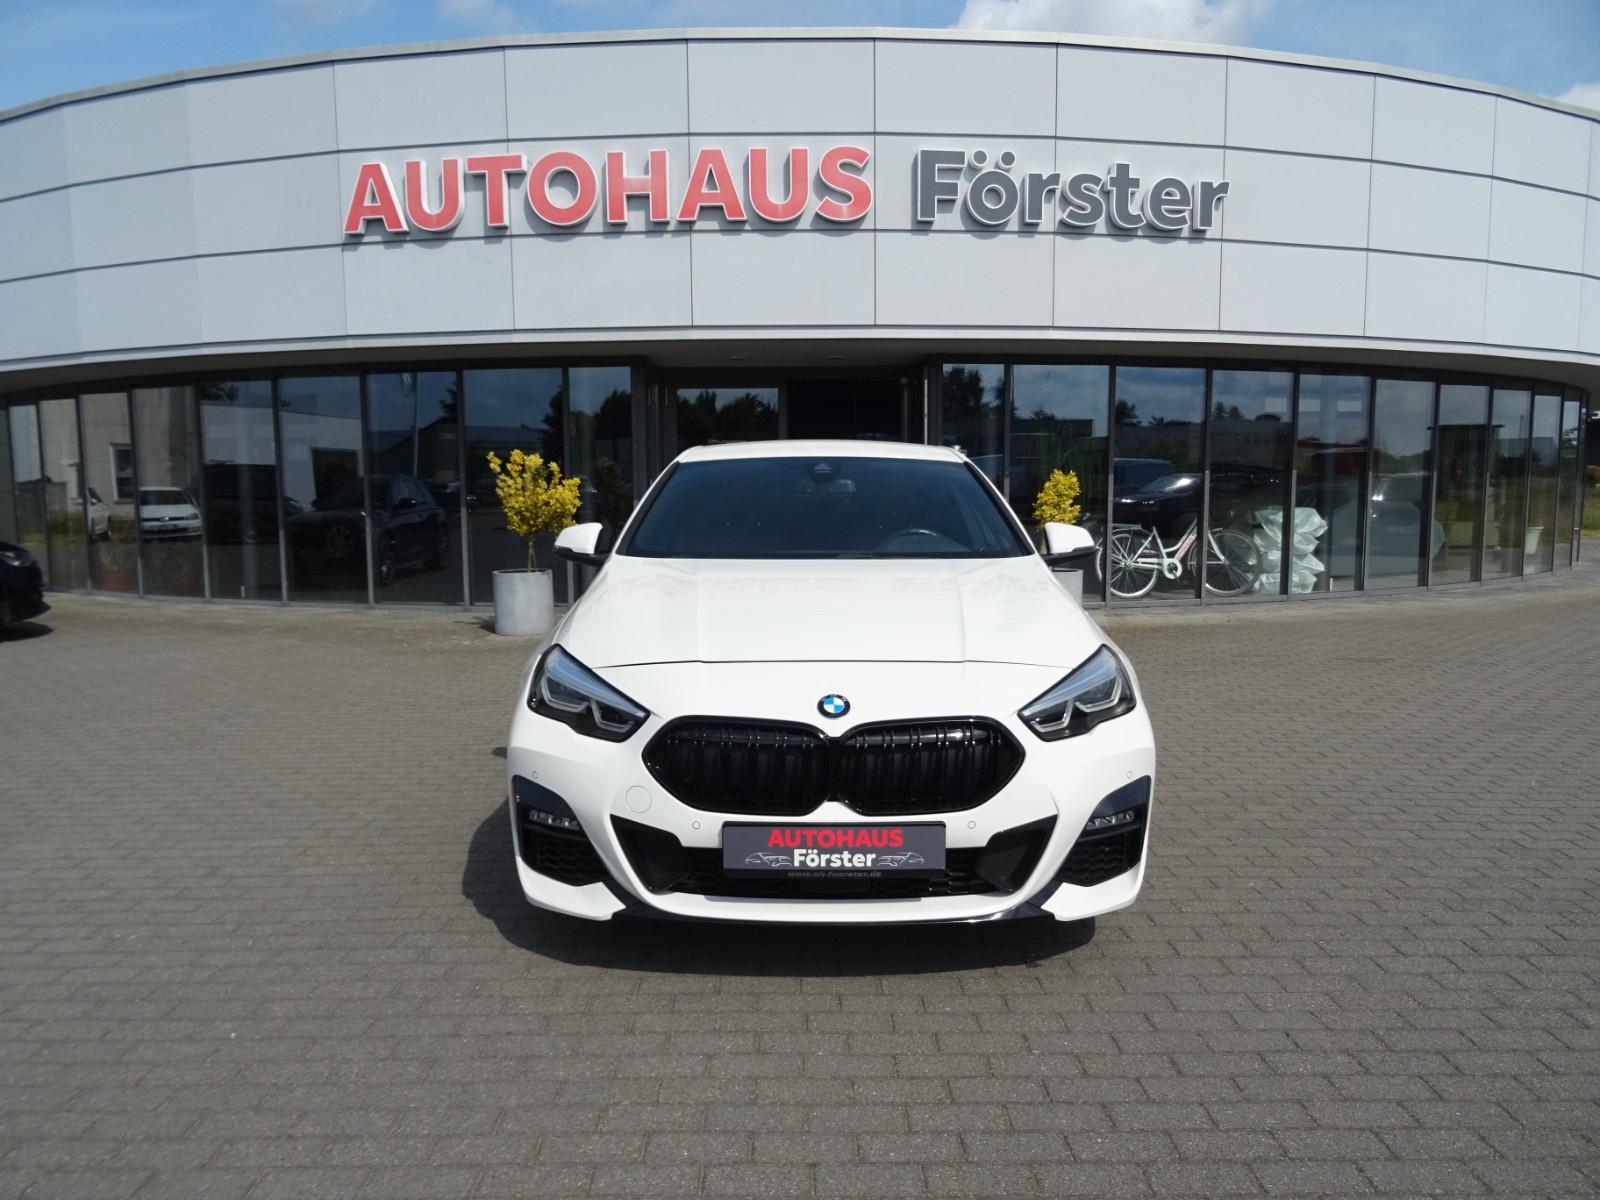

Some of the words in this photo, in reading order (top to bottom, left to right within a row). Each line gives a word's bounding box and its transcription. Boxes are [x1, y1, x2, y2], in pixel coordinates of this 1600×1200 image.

[343, 145, 874, 236] AUTOHAUS
[916, 149, 1231, 231] Förster
[767, 827, 904, 848] AUTOHAUS
[793, 848, 876, 867] Förster
